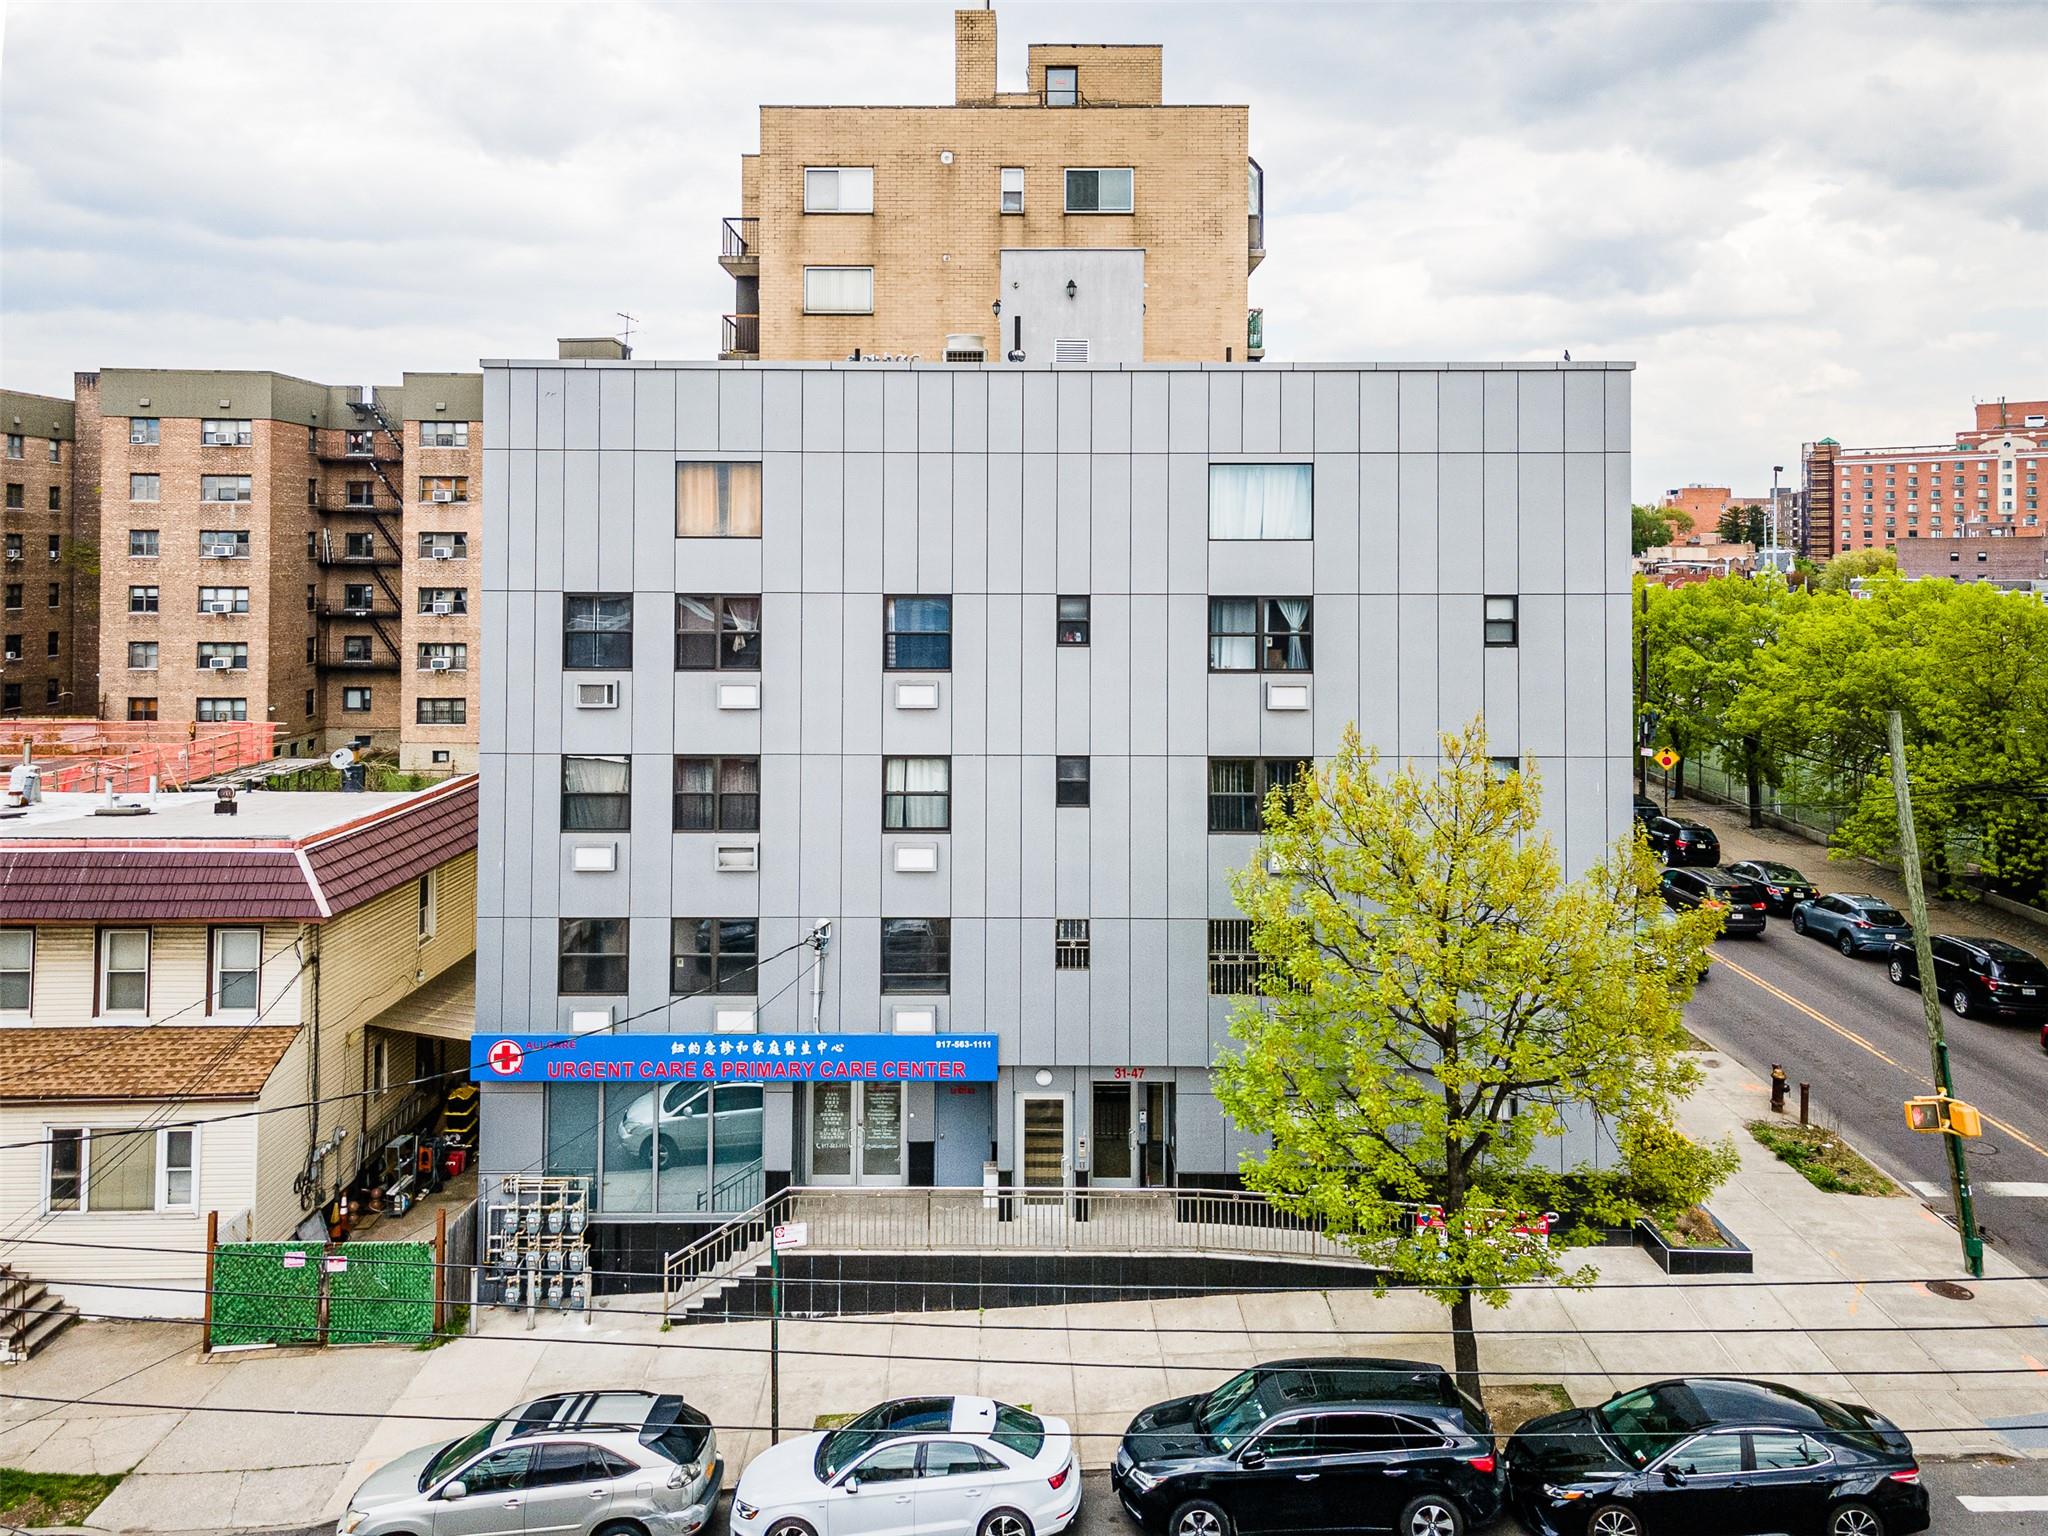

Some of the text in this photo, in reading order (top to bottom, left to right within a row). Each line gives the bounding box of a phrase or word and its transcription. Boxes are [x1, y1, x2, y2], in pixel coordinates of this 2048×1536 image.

[547, 1061, 967, 1079] URGENT CARE & PRIMARY CARE CENTER
[1114, 1067, 1145, 1079] 31-47
